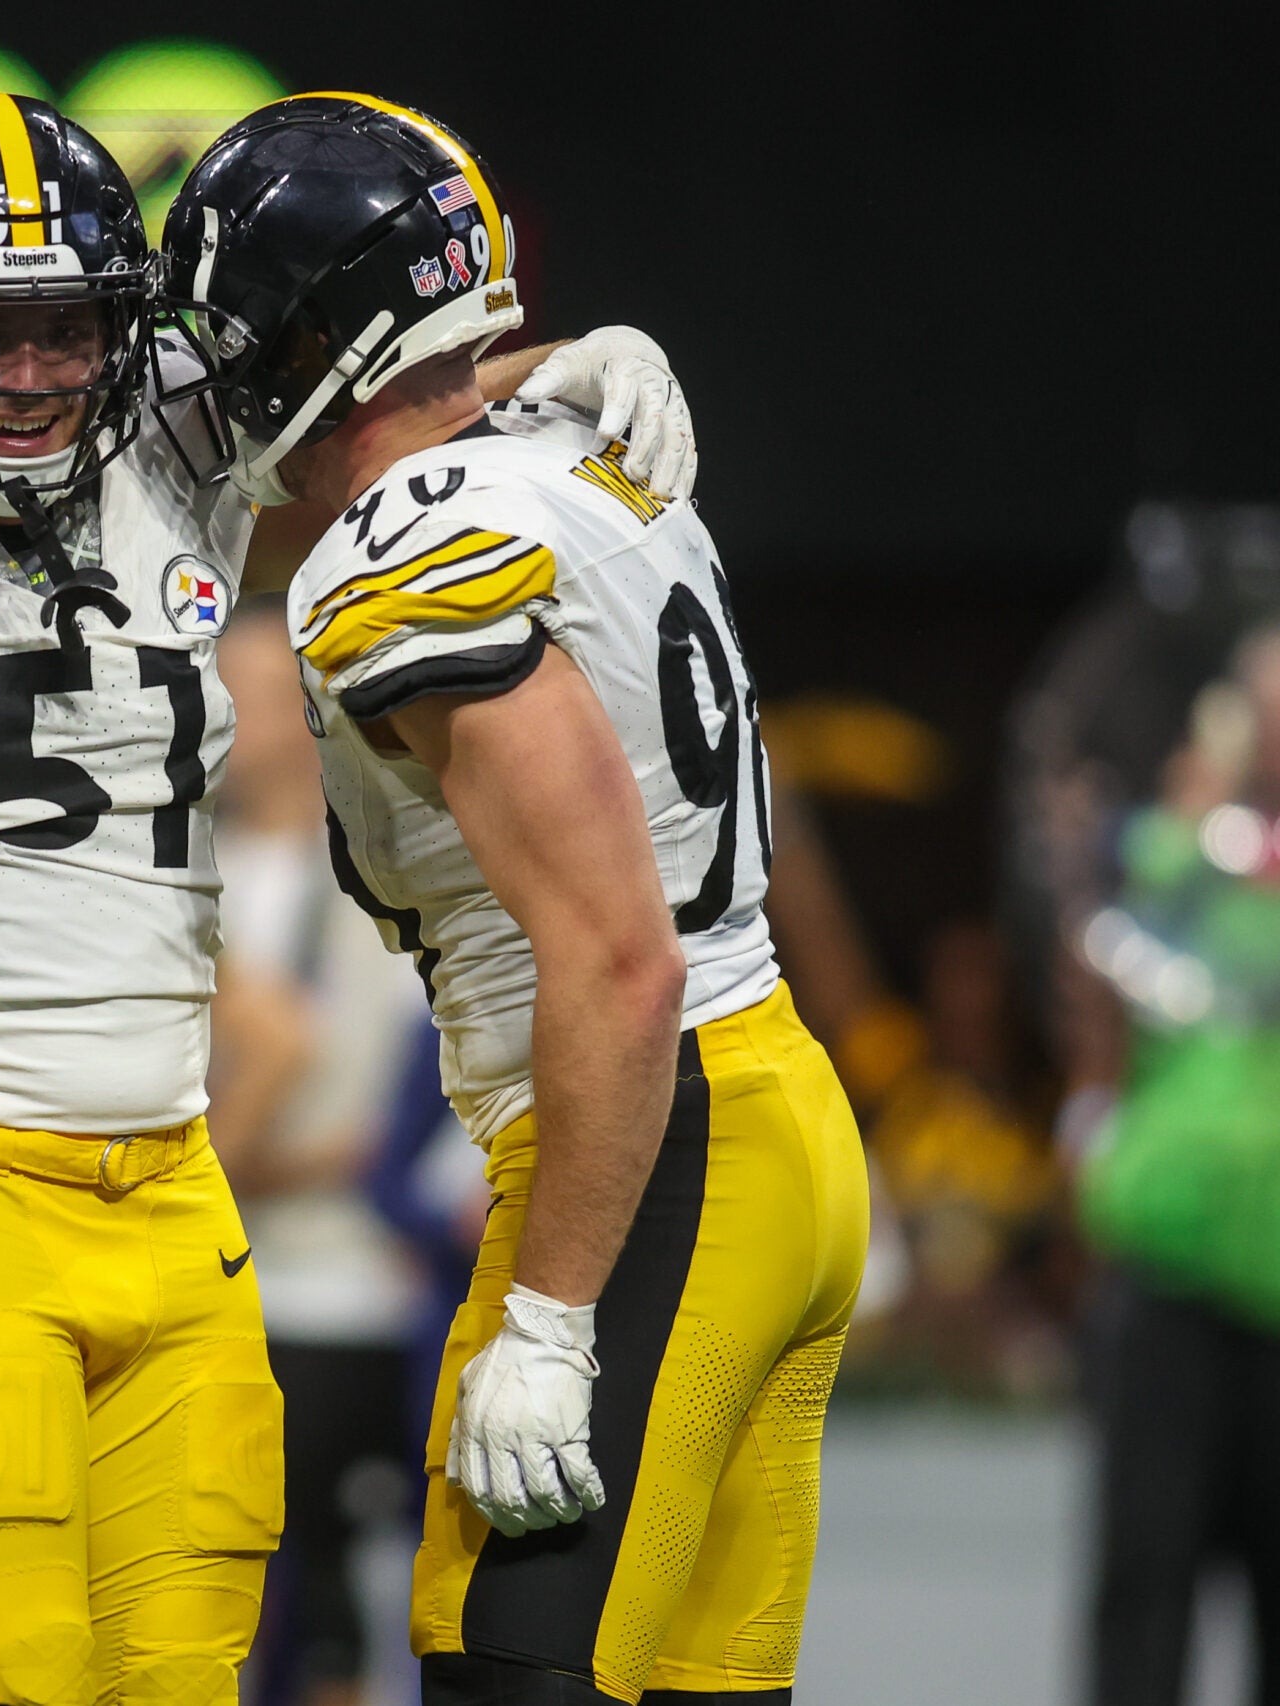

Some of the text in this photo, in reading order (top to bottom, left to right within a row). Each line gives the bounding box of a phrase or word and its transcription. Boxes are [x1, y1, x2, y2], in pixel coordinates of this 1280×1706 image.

[3, 248, 58, 267] Steelers
[470, 213, 516, 289] 90
[417, 272, 442, 292] NFL
[657, 560, 772, 935] 9
